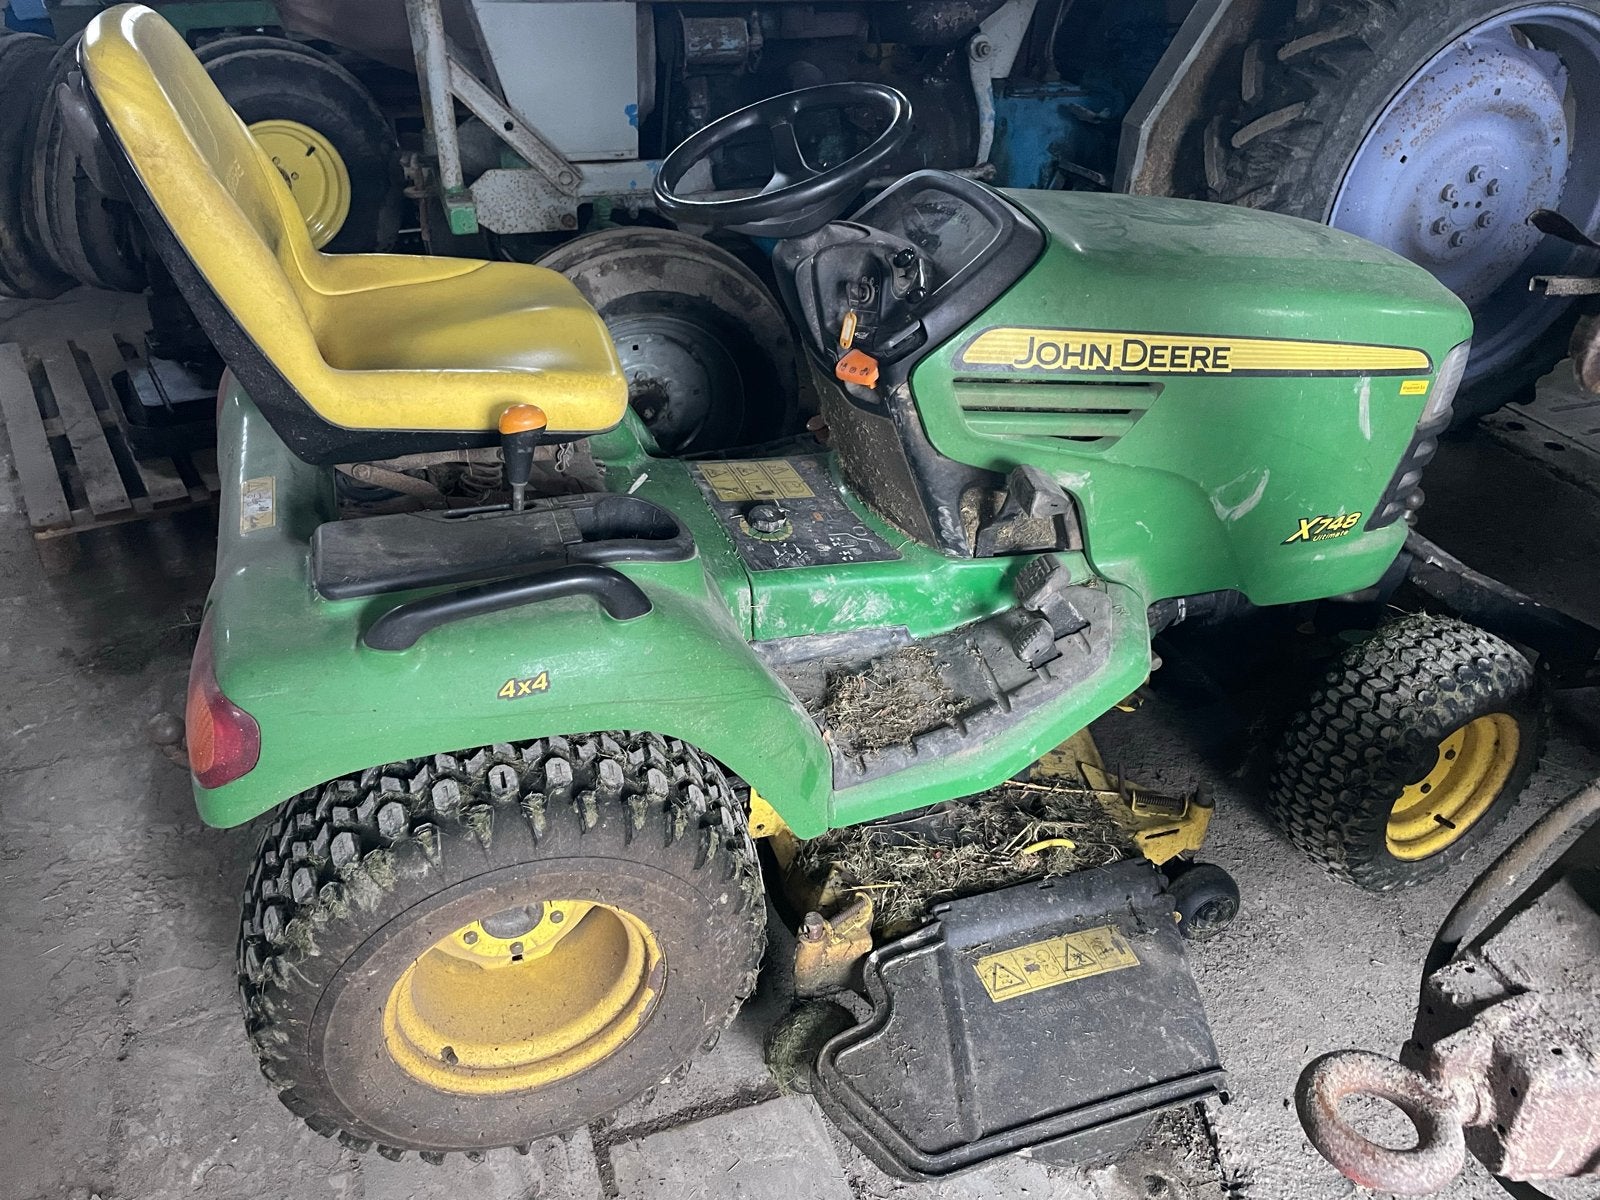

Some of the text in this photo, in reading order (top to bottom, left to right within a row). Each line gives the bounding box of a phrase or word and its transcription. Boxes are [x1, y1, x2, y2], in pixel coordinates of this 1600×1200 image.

[1014, 336, 1231, 369] JOHN DEERE
[1282, 511, 1362, 544] X748
[1312, 530, 1349, 542] Ultimate
[498, 671, 550, 700] 4x4
